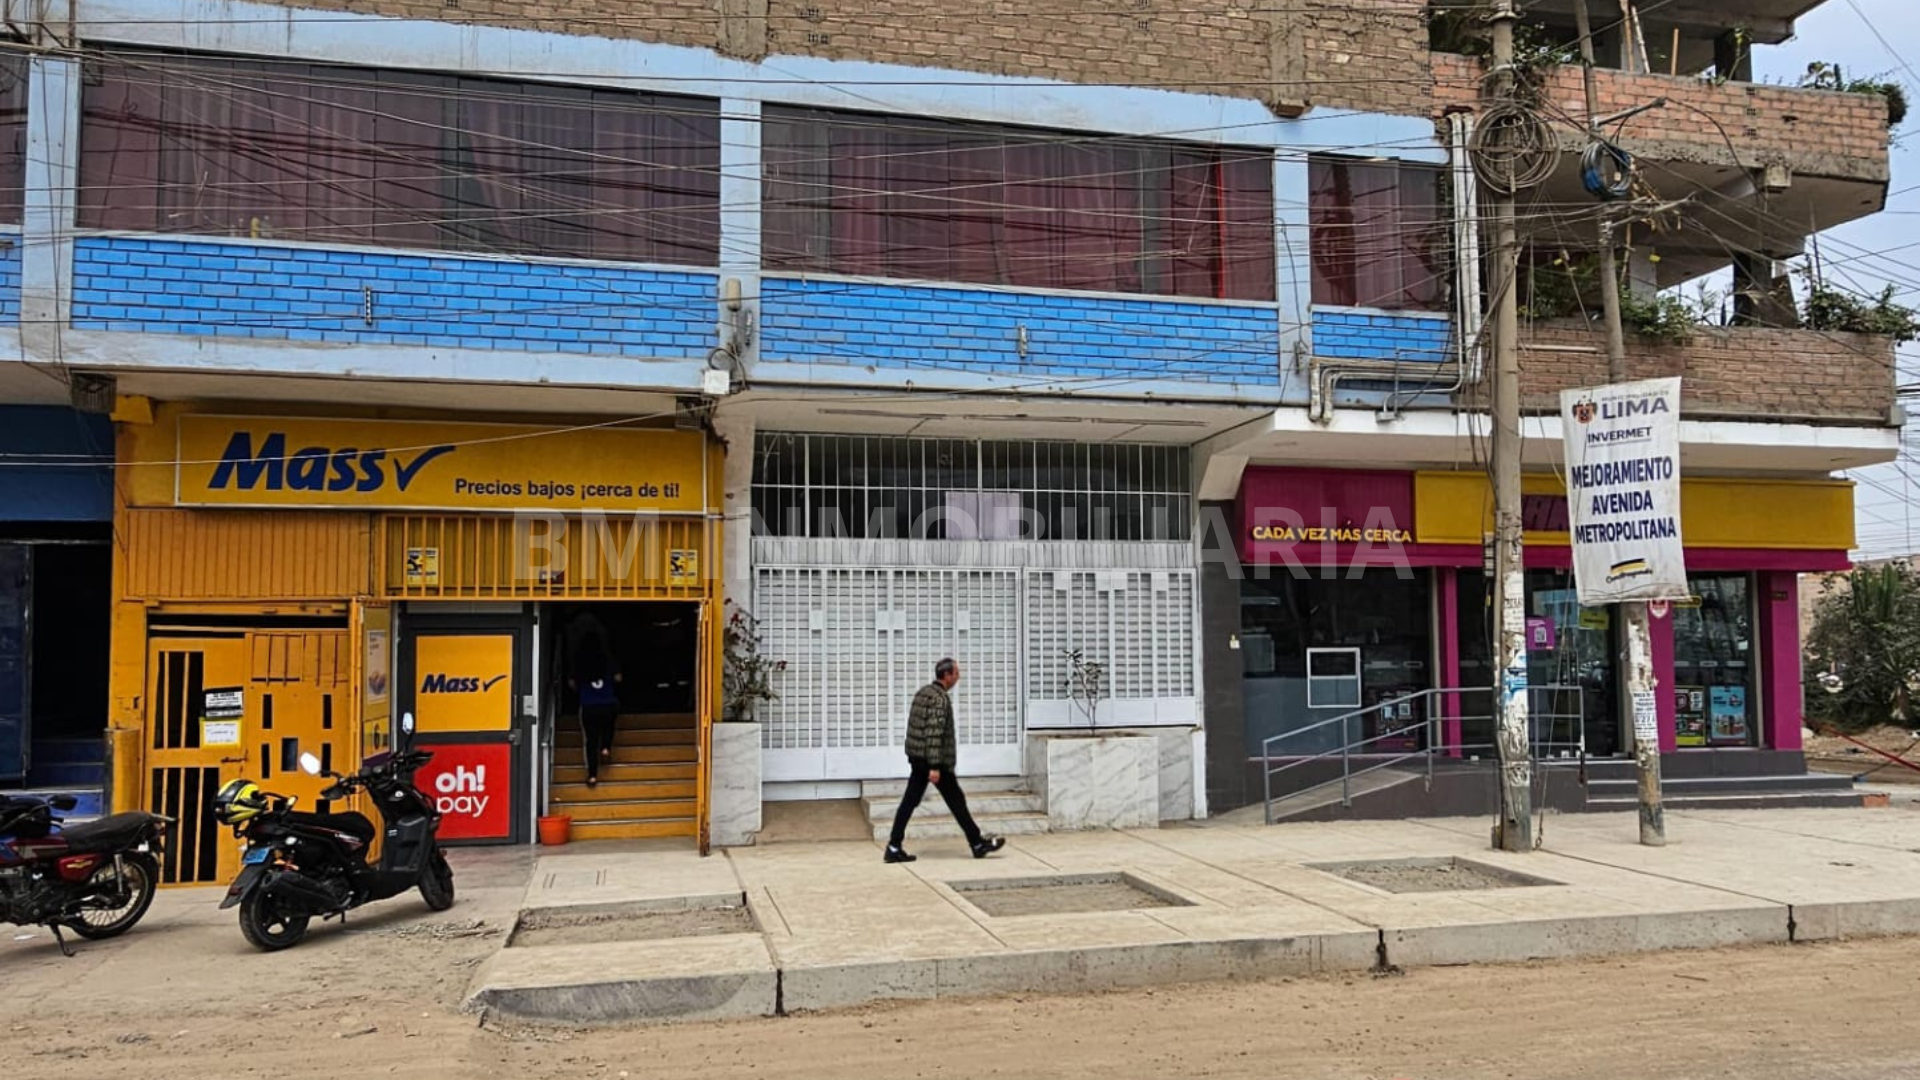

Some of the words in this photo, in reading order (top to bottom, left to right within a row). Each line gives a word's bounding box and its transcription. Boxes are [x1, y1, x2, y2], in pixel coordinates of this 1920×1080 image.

[1602, 396, 1669, 419] LIMA
[1587, 426, 1652, 443] INVERMET
[208, 432, 386, 492] Mass
[1571, 456, 1673, 489] MEJORAMIENTO
[455, 478, 522, 495] Precios
[527, 480, 575, 499] bajos
[581, 485, 633, 499] ¡cerca
[638, 483, 659, 497] de
[663, 484, 680, 498] ti!
[1592, 490, 1653, 515] AVENIDA
[1252, 526, 1295, 541] CADA
[1298, 528, 1327, 541] VEZ
[1330, 520, 1361, 541] MÁS
[1364, 528, 1412, 543] CERCA
[1575, 517, 1676, 544] METROPOLITANA
[421, 674, 480, 693] Mass
[435, 764, 486, 793] oh!
[436, 795, 489, 818] pay
